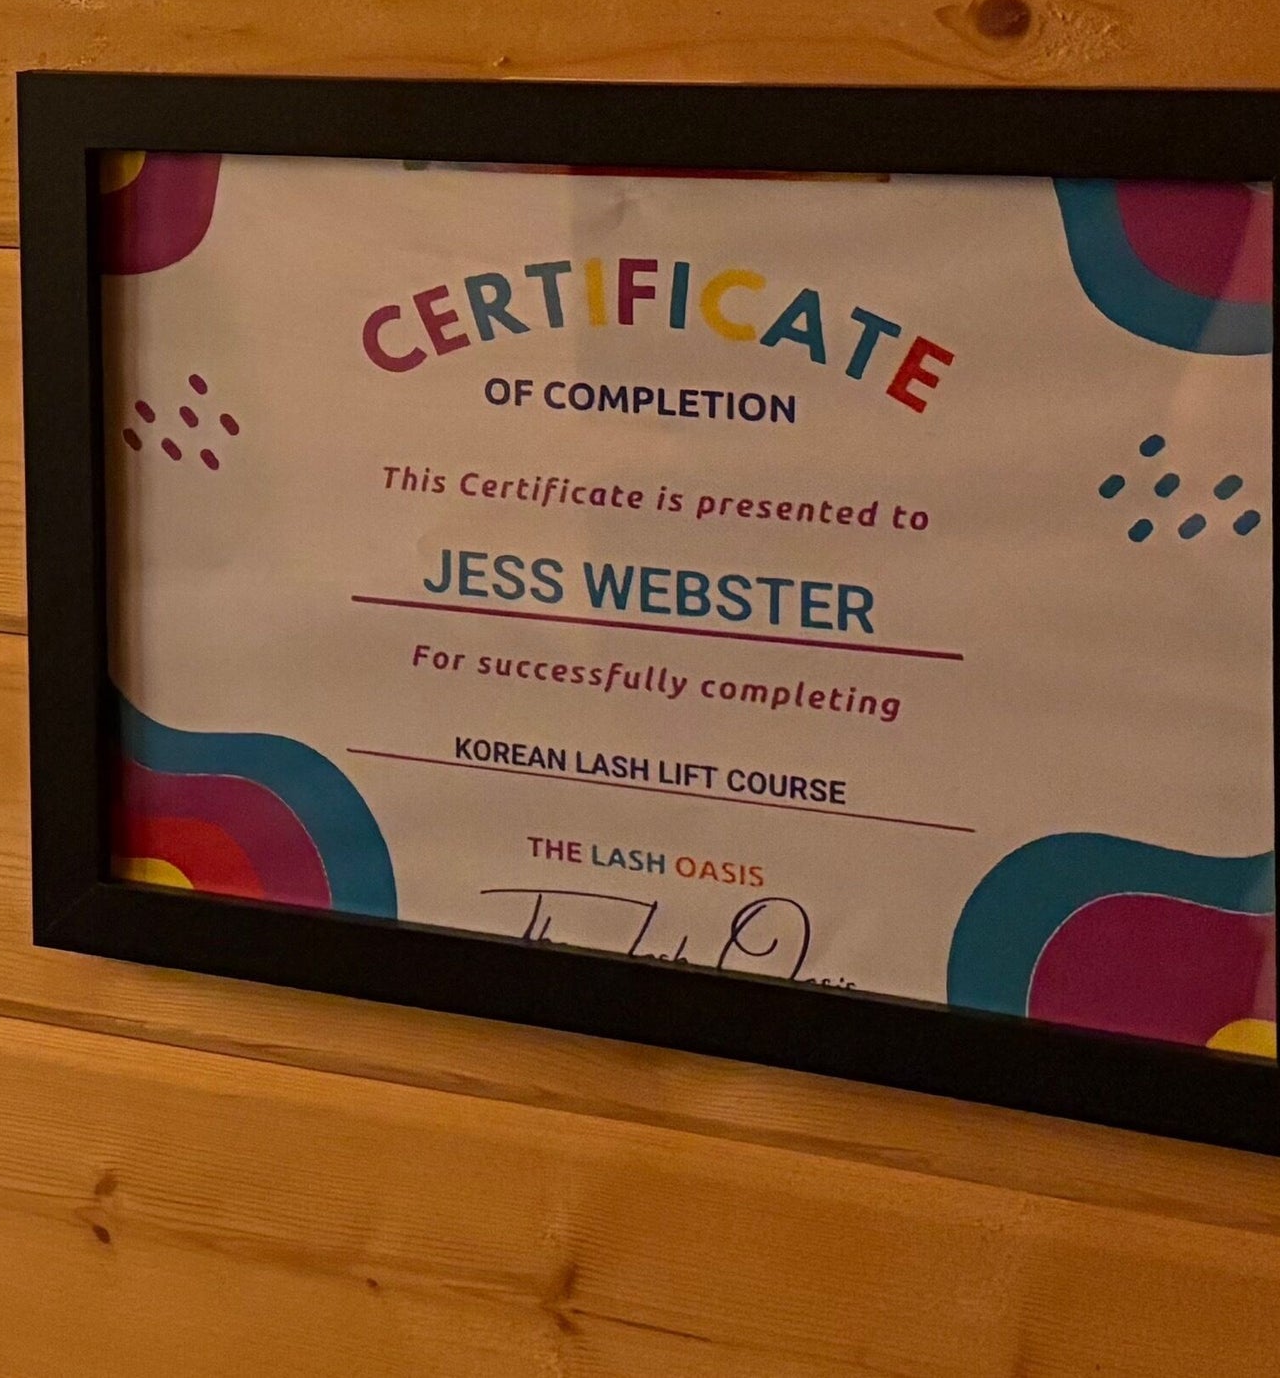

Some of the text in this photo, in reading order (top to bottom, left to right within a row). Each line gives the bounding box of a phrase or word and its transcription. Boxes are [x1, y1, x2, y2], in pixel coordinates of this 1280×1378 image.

[361, 257, 955, 414] CERTIFICATE
[485, 378, 796, 424] OF COMPLETION
[383, 466, 929, 532] This Certificate is presented to
[423, 548, 875, 635] JESS WEBSTER
[412, 645, 901, 723] For successfully completing
[455, 736, 847, 805] KOREAN LASH LIFT COURSE
[527, 836, 764, 889] THE LASH OASIS
